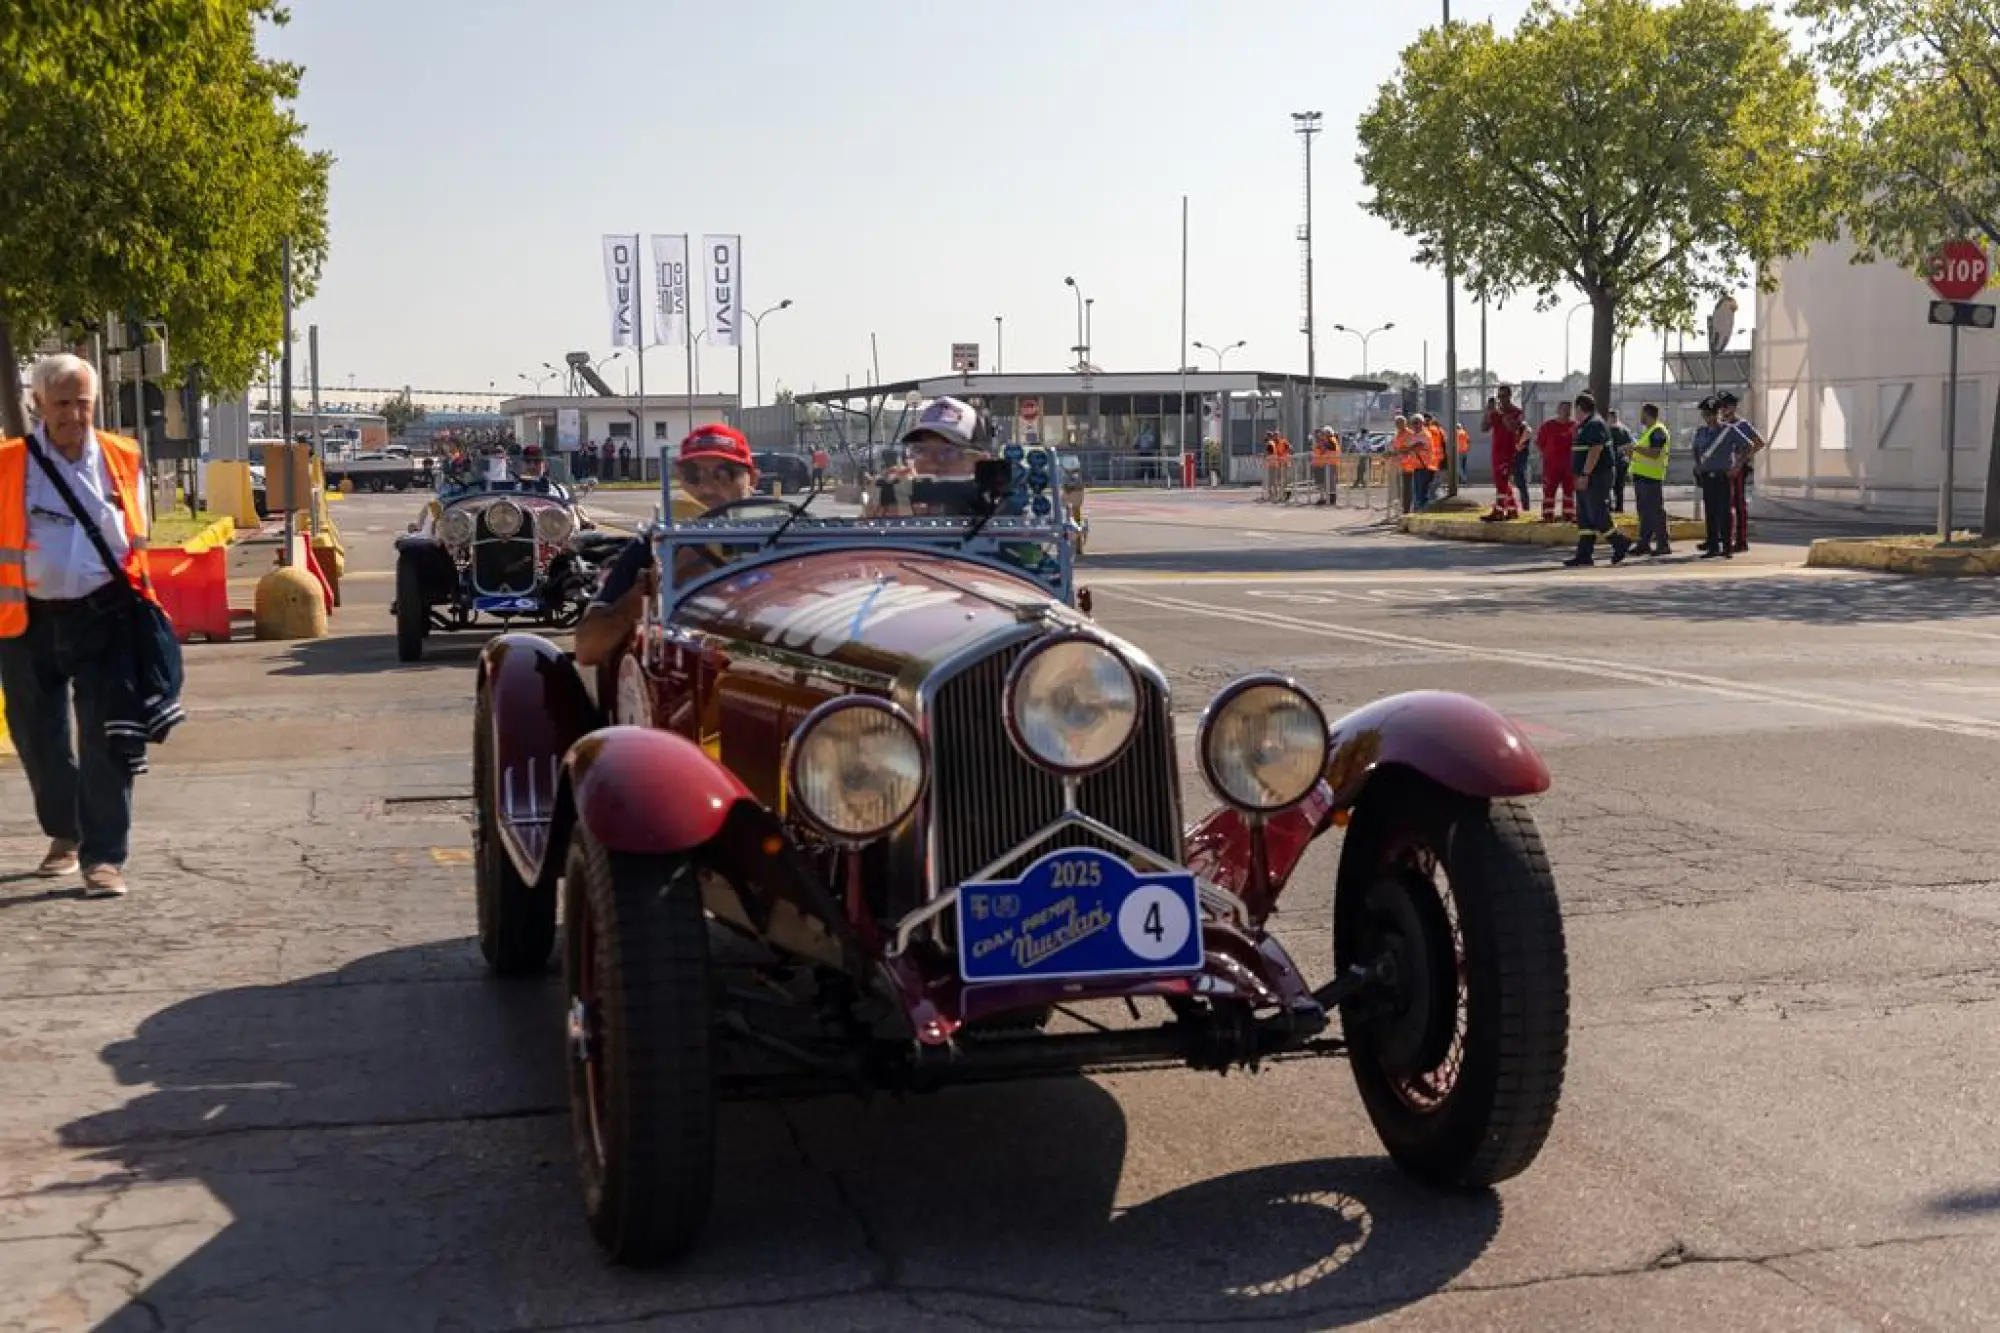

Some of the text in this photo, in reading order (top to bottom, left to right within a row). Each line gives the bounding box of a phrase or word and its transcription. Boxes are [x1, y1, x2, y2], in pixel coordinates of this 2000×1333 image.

[1931, 258, 1985, 282] STOP
[1050, 861, 1103, 888] 2025
[1143, 901, 1165, 943] 4
